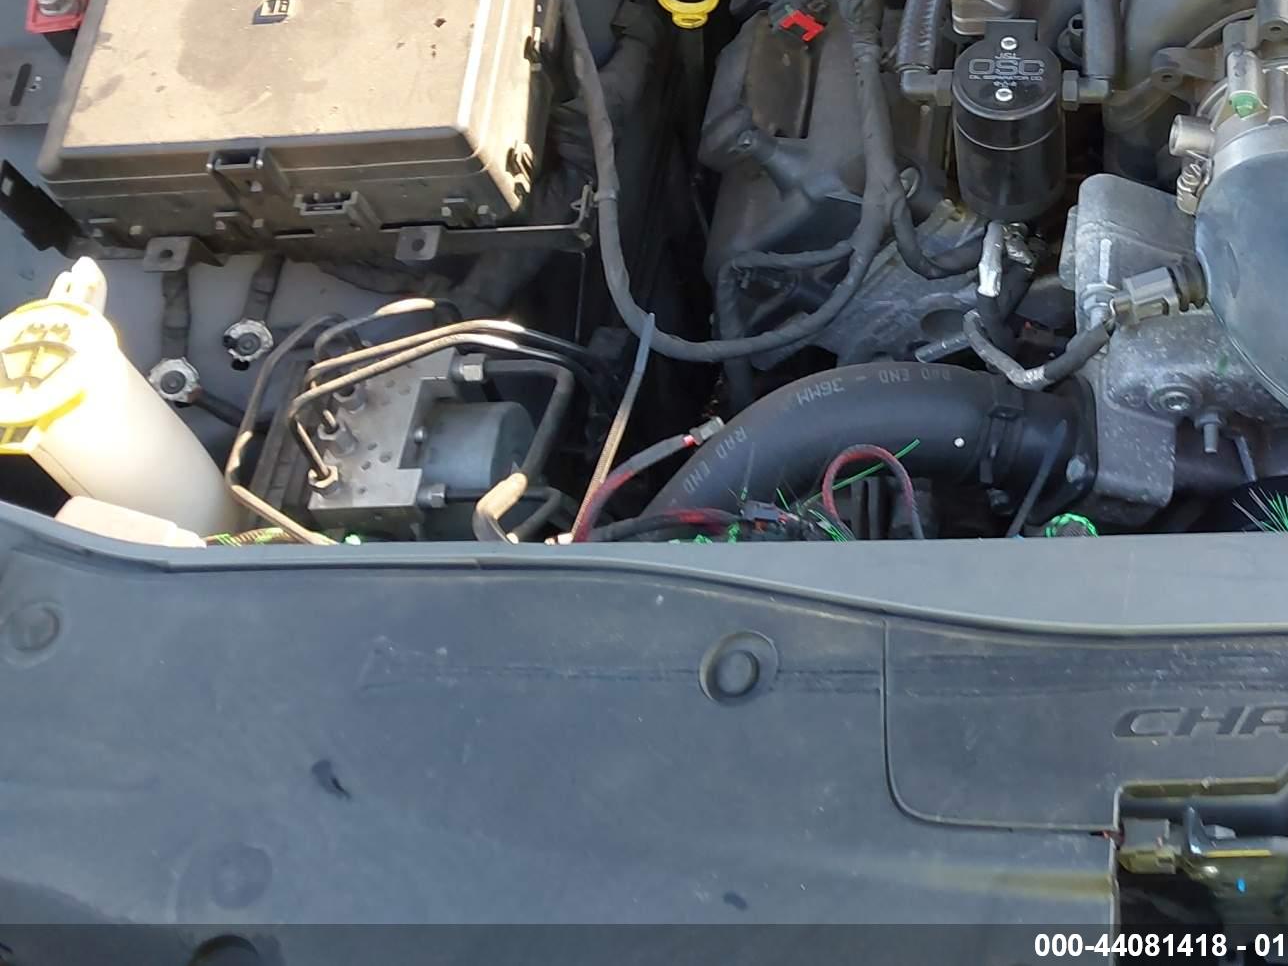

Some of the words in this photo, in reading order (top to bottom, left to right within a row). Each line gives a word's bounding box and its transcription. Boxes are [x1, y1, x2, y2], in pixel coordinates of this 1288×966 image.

[968, 58, 1045, 76] OSC
[876, 368, 910, 384] END
[795, 376, 846, 406] 36MM
[713, 424, 749, 460] RAD
